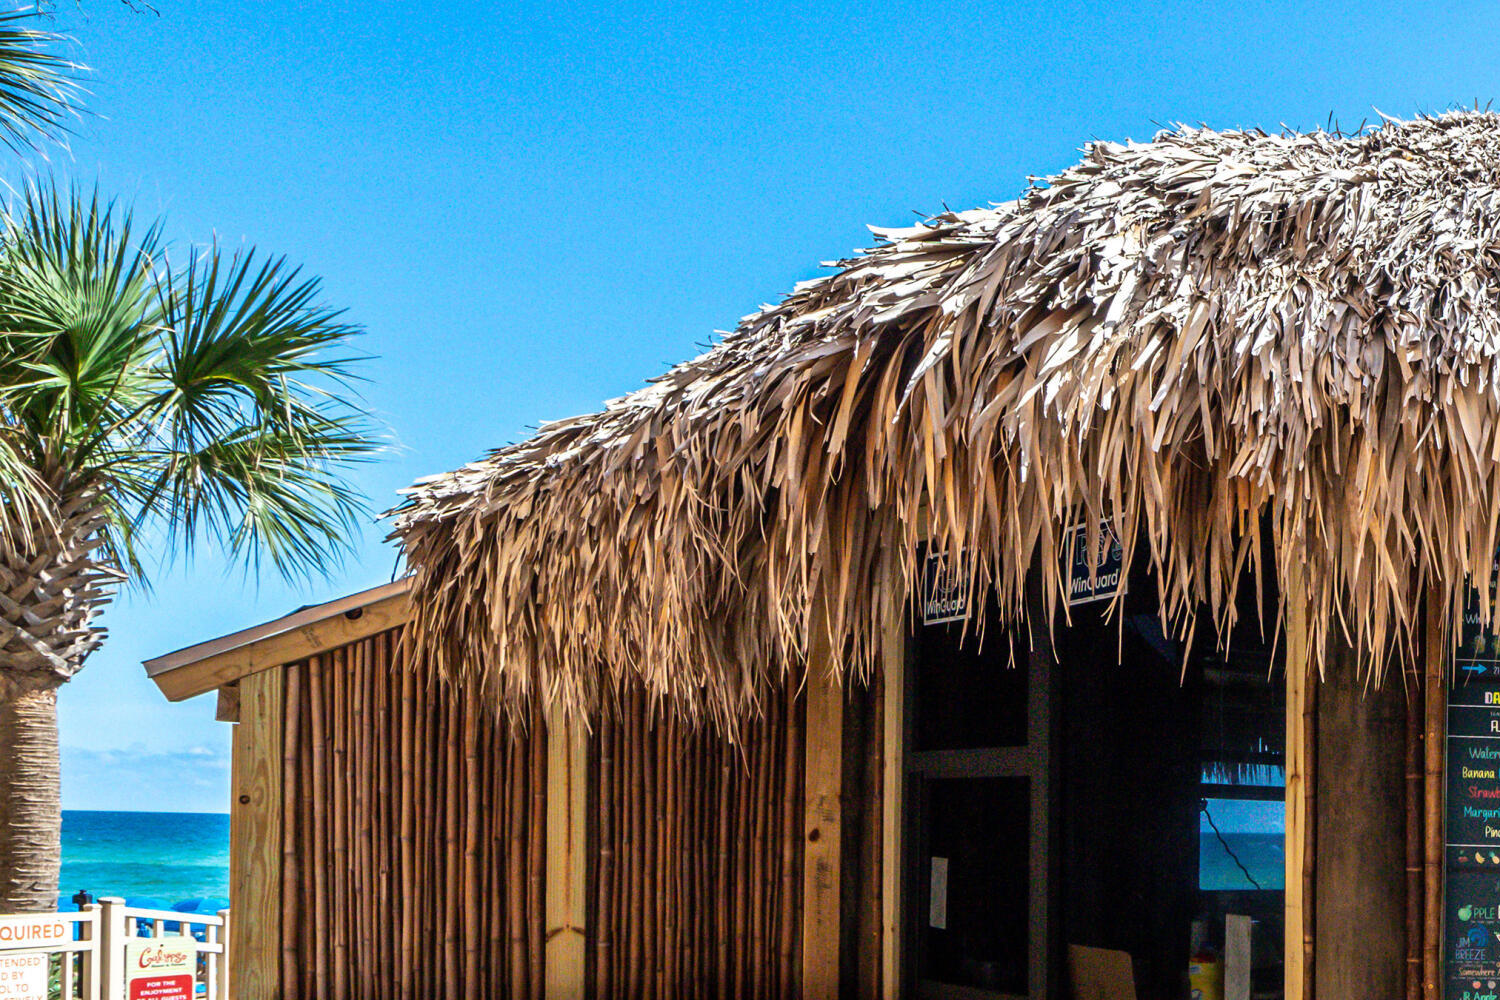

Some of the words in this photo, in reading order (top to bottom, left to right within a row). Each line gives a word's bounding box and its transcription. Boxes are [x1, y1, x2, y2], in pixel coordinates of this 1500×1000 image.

[1462, 767, 1495, 780] Banana
[0, 924, 65, 941] QUIRED
[12, 971, 25, 980] BY
[16, 983, 29, 993] TO
[140, 987, 182, 997] ENJOYMENT
